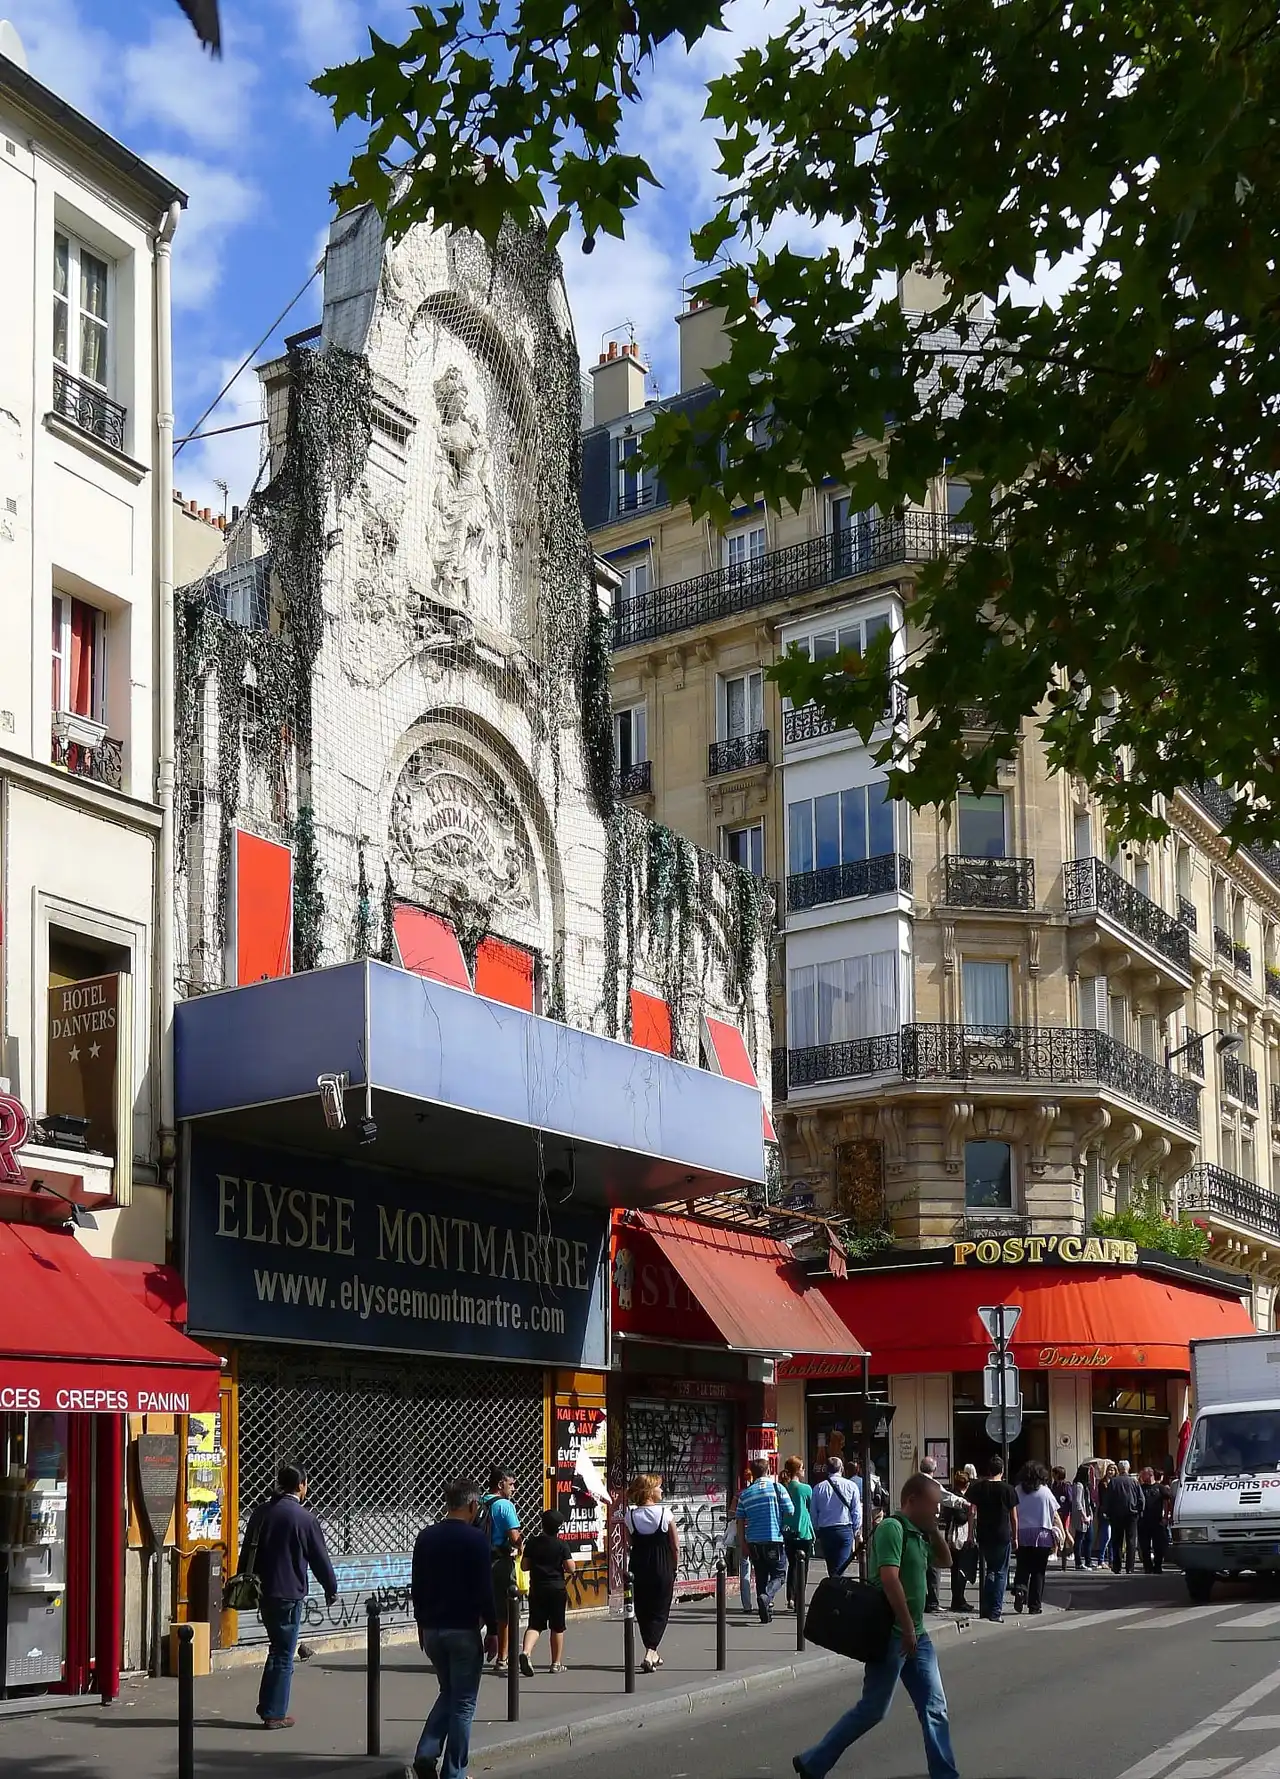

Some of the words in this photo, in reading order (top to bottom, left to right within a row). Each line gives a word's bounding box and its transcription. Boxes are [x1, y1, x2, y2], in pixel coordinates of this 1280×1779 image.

[62, 984, 107, 1012] HOTEL
[52, 1007, 117, 1040] D'ANVERS
[215, 1174, 356, 1257] ELYSEE
[376, 1204, 590, 1291] MONTMARTRE
[1038, 1347, 1113, 1367] Drinks
[0, 1387, 41, 1408] CES
[56, 1389, 129, 1410] CREPES
[137, 1391, 190, 1412] PANINI
[577, 1423, 594, 1434] JAY
[1185, 1480, 1260, 1492] TRANSPORTS
